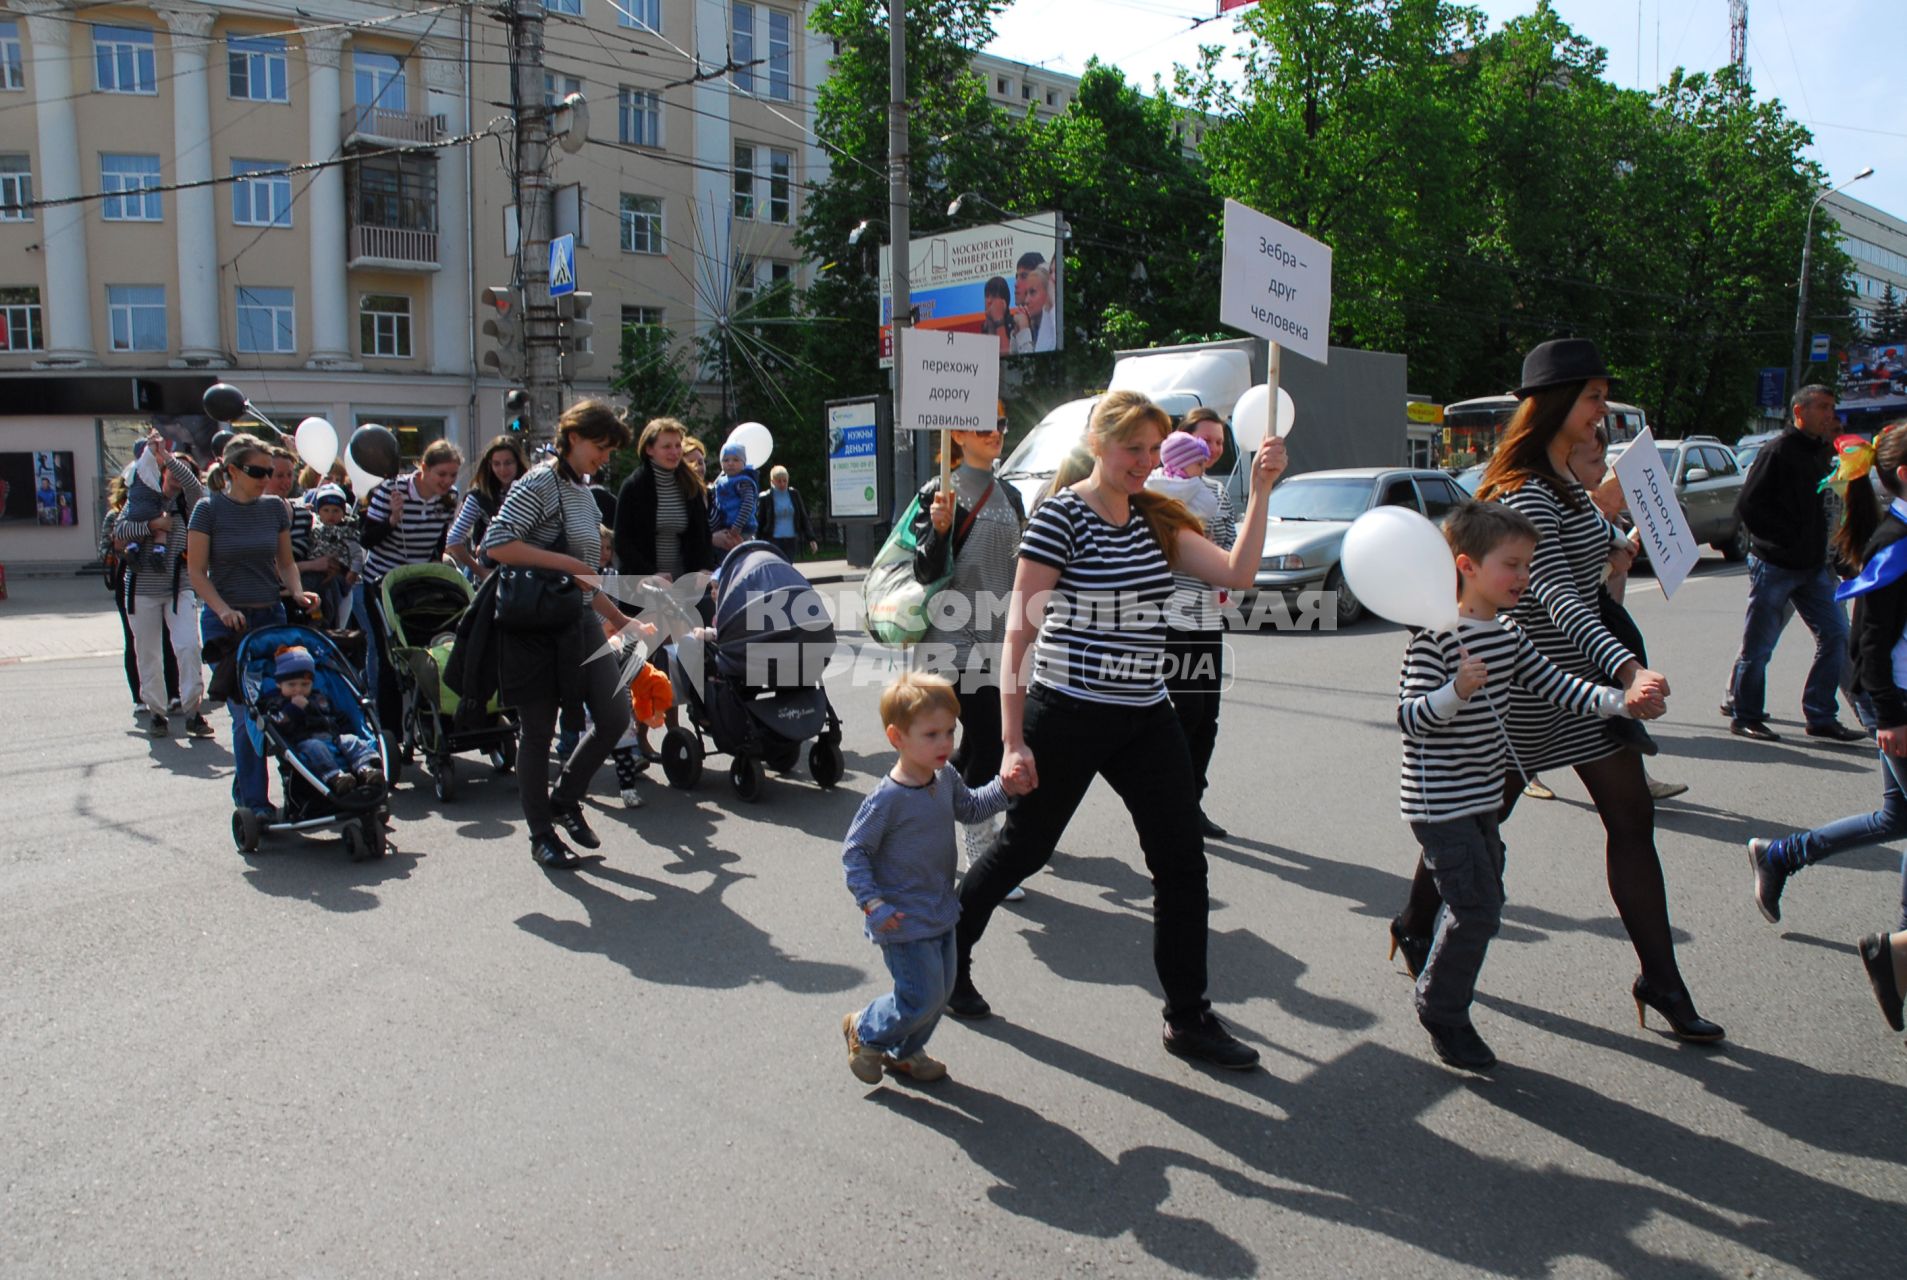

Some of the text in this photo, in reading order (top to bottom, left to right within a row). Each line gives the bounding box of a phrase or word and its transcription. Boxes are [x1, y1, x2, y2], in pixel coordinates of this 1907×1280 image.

[952, 235, 1013, 255] МОСКОВСКИЙ
[1259, 236, 1297, 268] Зебра
[952, 248, 1013, 266] УНИВЕРСИТЕТ
[1268, 278, 1297, 302] друг
[1251, 304, 1308, 341] человека
[947, 332, 954, 345] Я
[922, 359, 979, 376] перехожу
[929, 387, 970, 403] дорогу
[918, 413, 980, 428] правильно
[848, 429, 873, 441] НУЖНЫ
[845, 442, 873, 456] ДЕНЬГИ?
